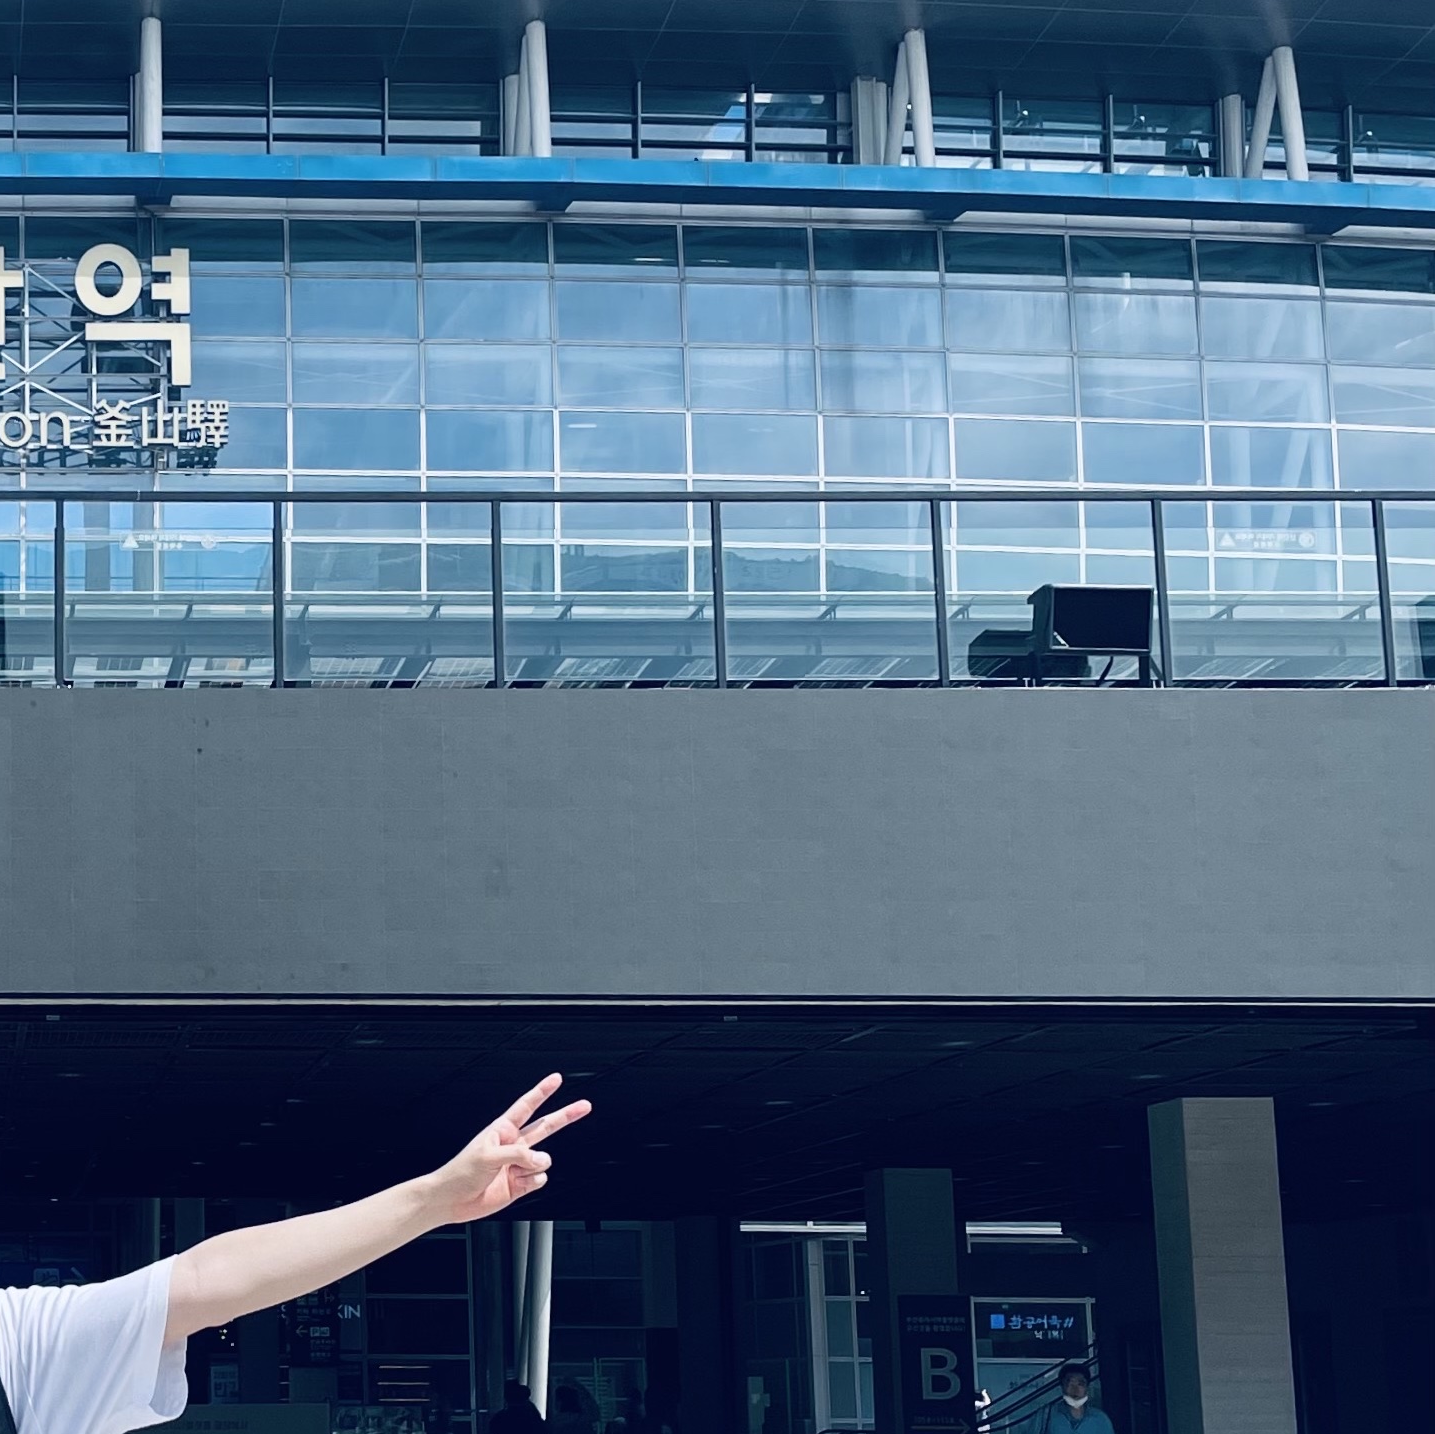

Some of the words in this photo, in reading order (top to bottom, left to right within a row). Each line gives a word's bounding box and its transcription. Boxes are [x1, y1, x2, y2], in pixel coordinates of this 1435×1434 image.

[91, 398, 230, 448] 釜山驛
[920, 1347, 962, 1401] B
